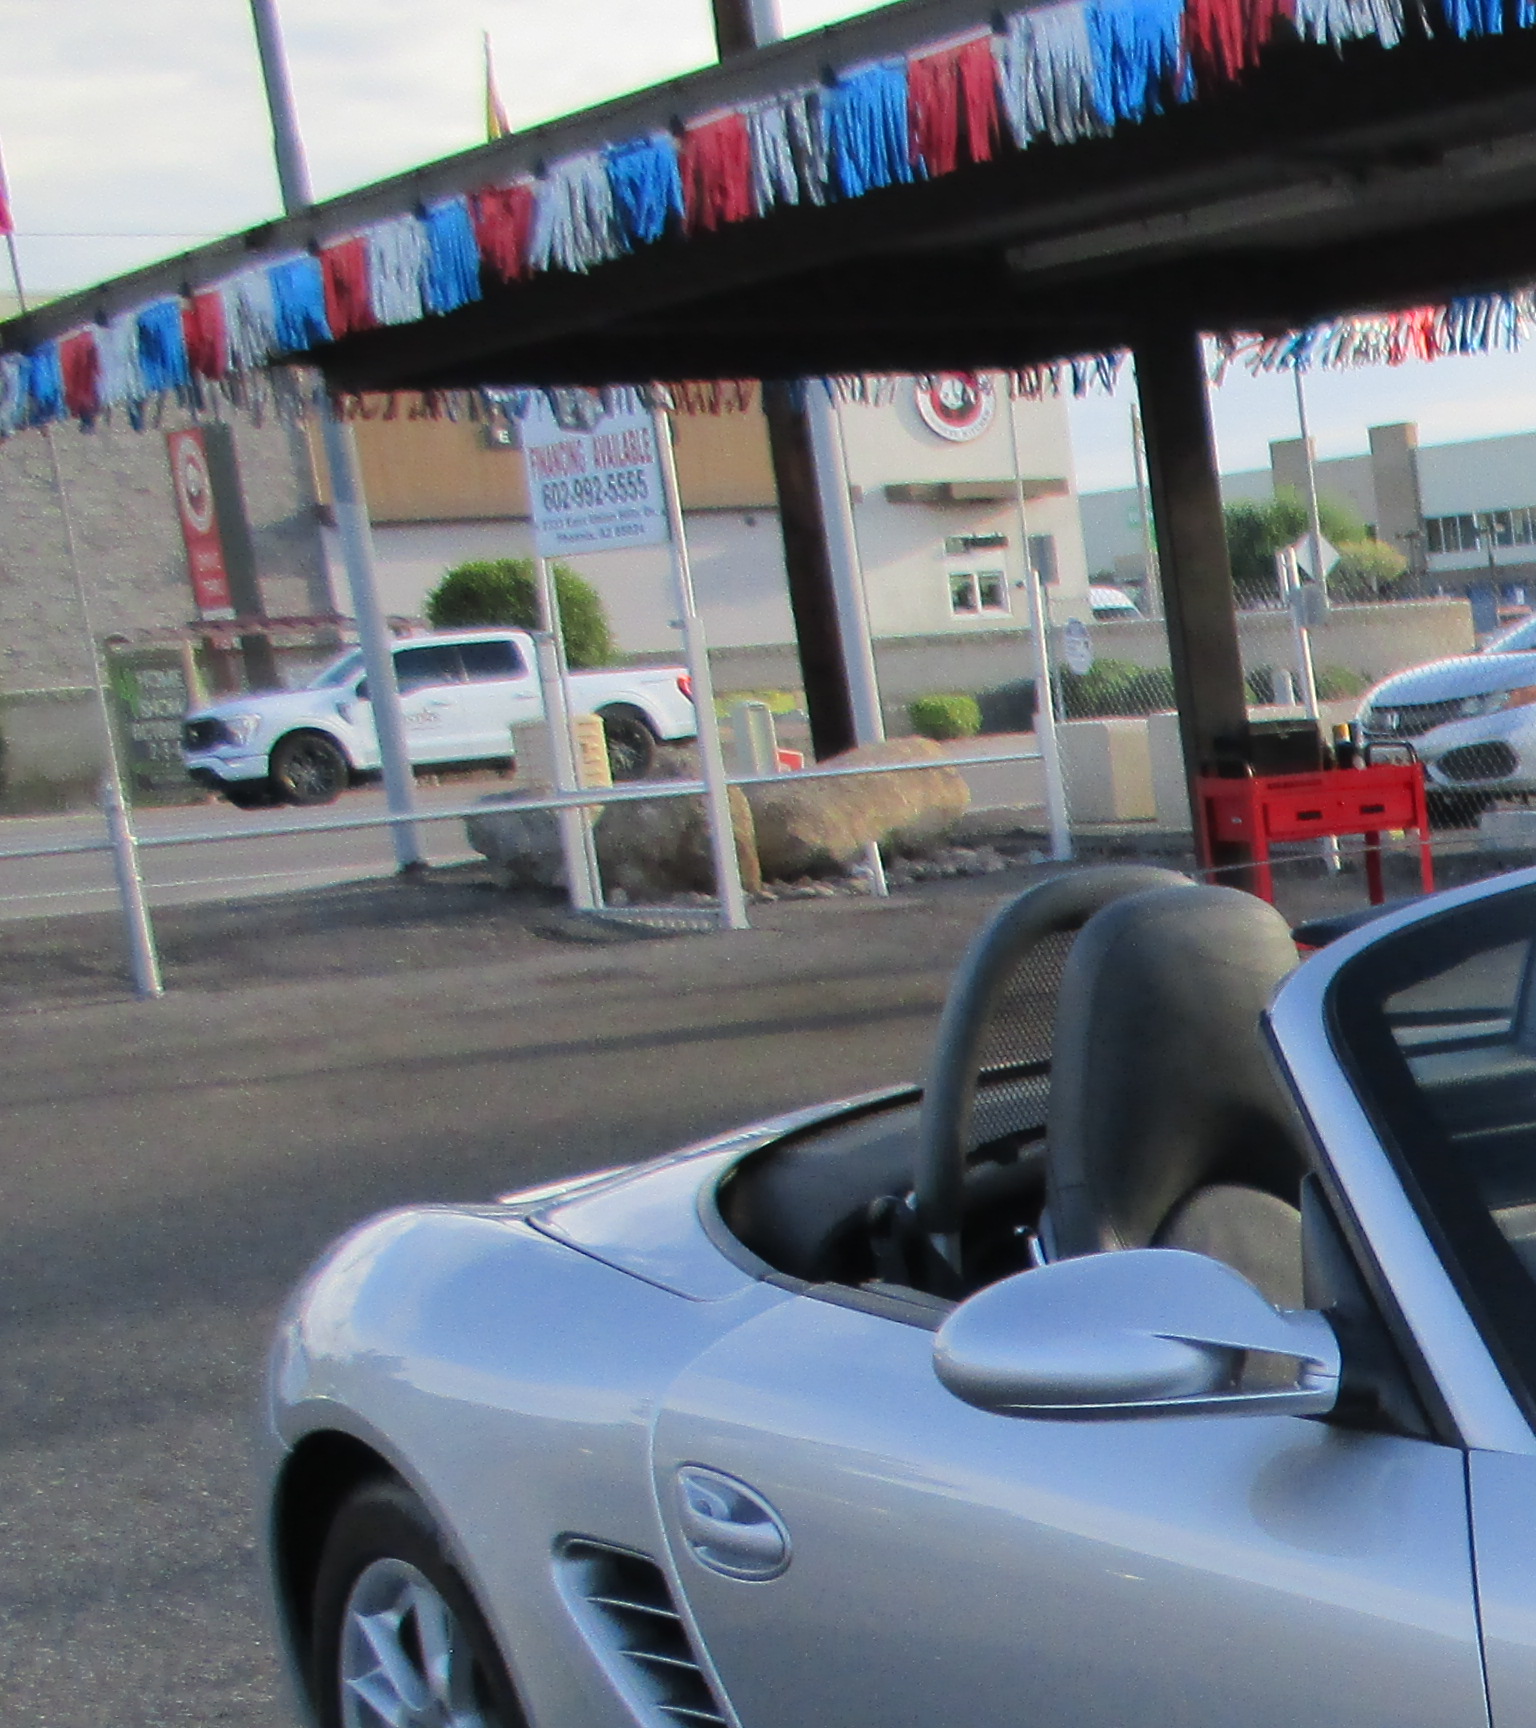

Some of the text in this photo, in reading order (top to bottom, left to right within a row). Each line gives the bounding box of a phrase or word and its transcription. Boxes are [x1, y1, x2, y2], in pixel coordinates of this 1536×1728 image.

[528, 427, 654, 479] FINANCING AVAILABLE
[542, 468, 650, 513] 602-992-5555
